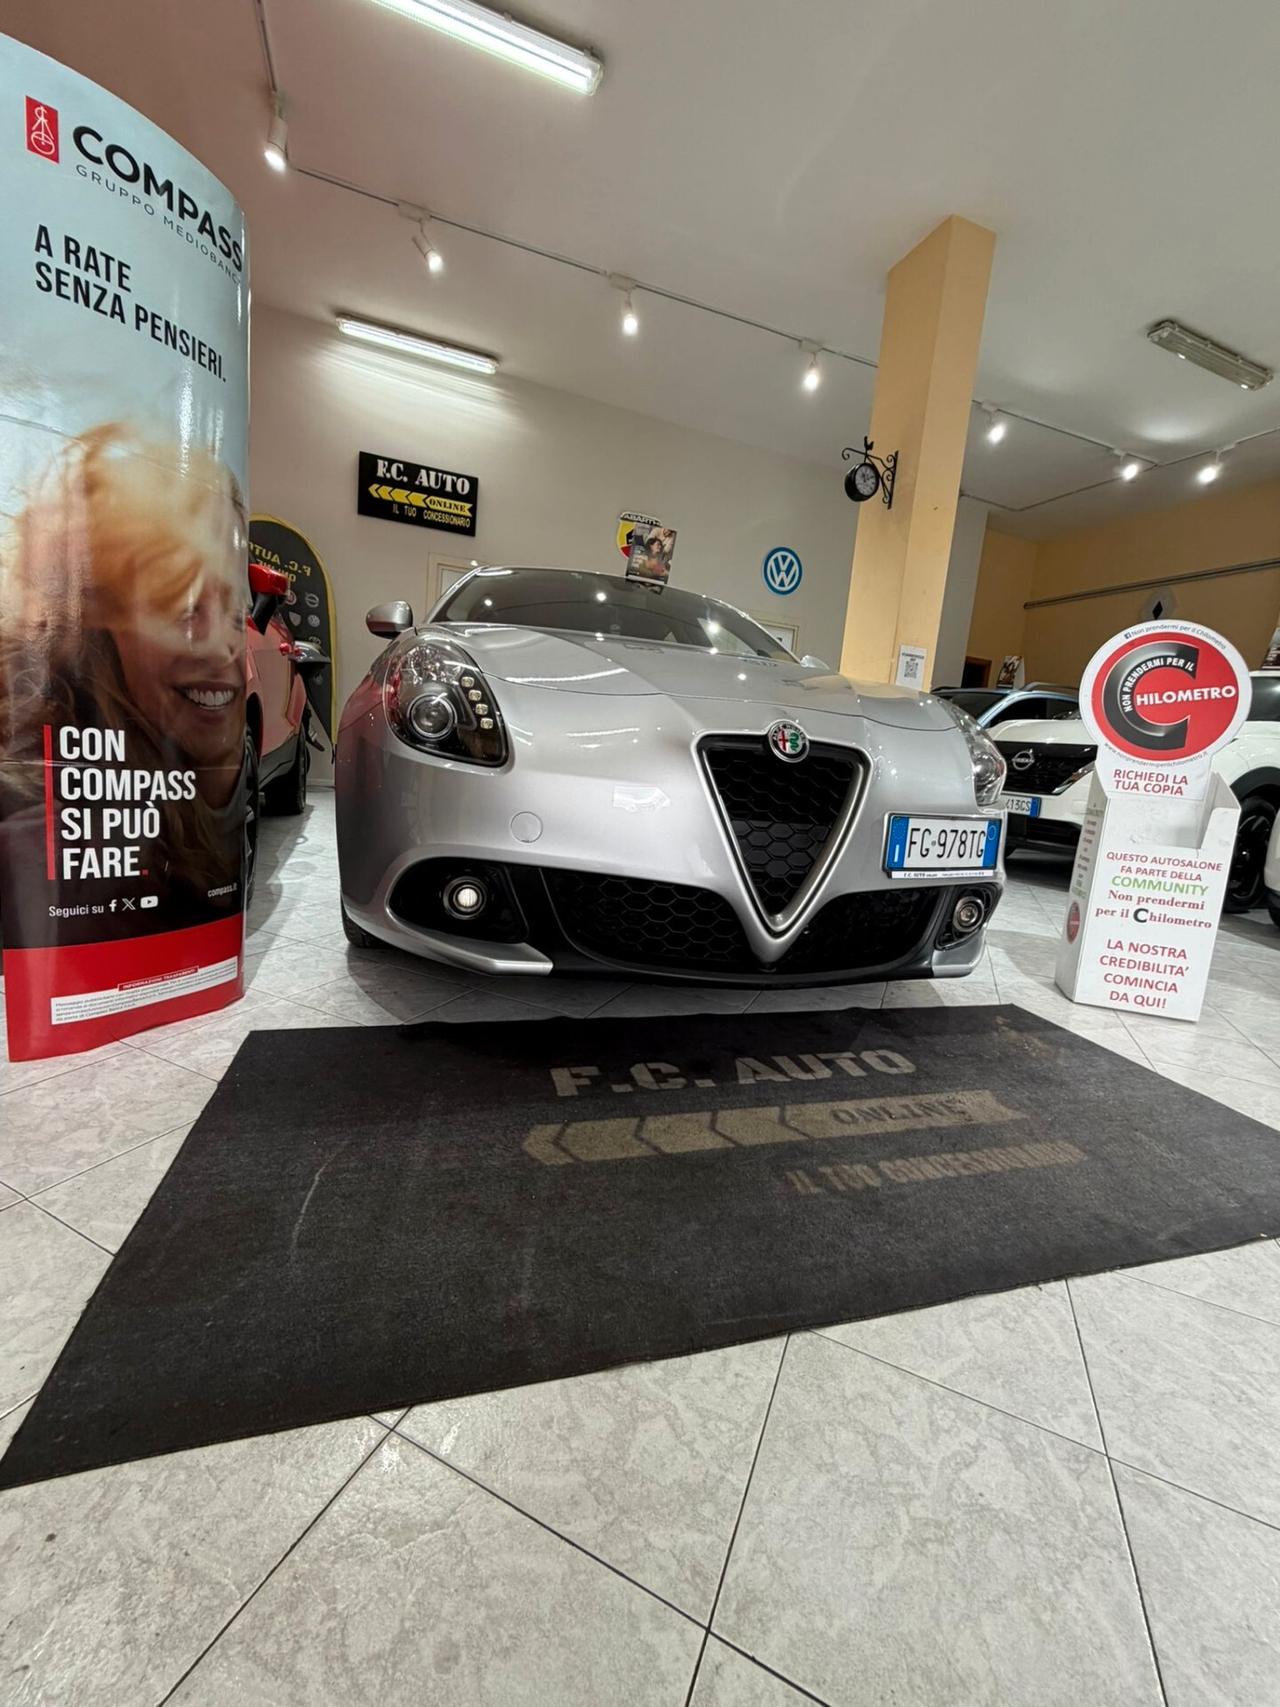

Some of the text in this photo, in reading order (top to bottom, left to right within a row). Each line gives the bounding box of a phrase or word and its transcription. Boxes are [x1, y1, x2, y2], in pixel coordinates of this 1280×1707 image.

[73, 126, 242, 272] COMPASS
[76, 164, 241, 284] GRUPPO MEDIOBANC
[35, 224, 131, 293] A RATE
[35, 261, 226, 383] SENZA PENSIERI.
[376, 459, 470, 495] F.C. AUTO
[392, 503, 471, 528] IL TUO CONCESSIONARIO
[429, 498, 467, 512] ONLINE
[1122, 657, 1196, 712] NON PRENDERMI PER IL
[58, 726, 125, 762] CON
[60, 766, 196, 801] COMPASS
[1114, 769, 1188, 785] RICHIEDI LA
[1115, 780, 1183, 796] TUA COPIA
[61, 801, 160, 840] SI PUÒ
[62, 846, 149, 880] FARE.
[1106, 851, 1222, 872] QUESTO AUTOSALONE
[1120, 865, 1202, 882] FA PARTE DELLA
[207, 883, 237, 898] compass.it
[1111, 875, 1209, 896] COMMUNITY
[48, 903, 104, 918] Seguici su
[1108, 890, 1205, 911] Non prendermi
[1095, 907, 1212, 929] per il Chilometro
[1106, 939, 1187, 960] LA NOSTRA
[1104, 973, 1178, 993] COMINCIA
[1109, 990, 1166, 1009] DA QUI!
[550, 1049, 916, 1097] F.C. AUTO
[831, 1100, 966, 1125] ONLINE
